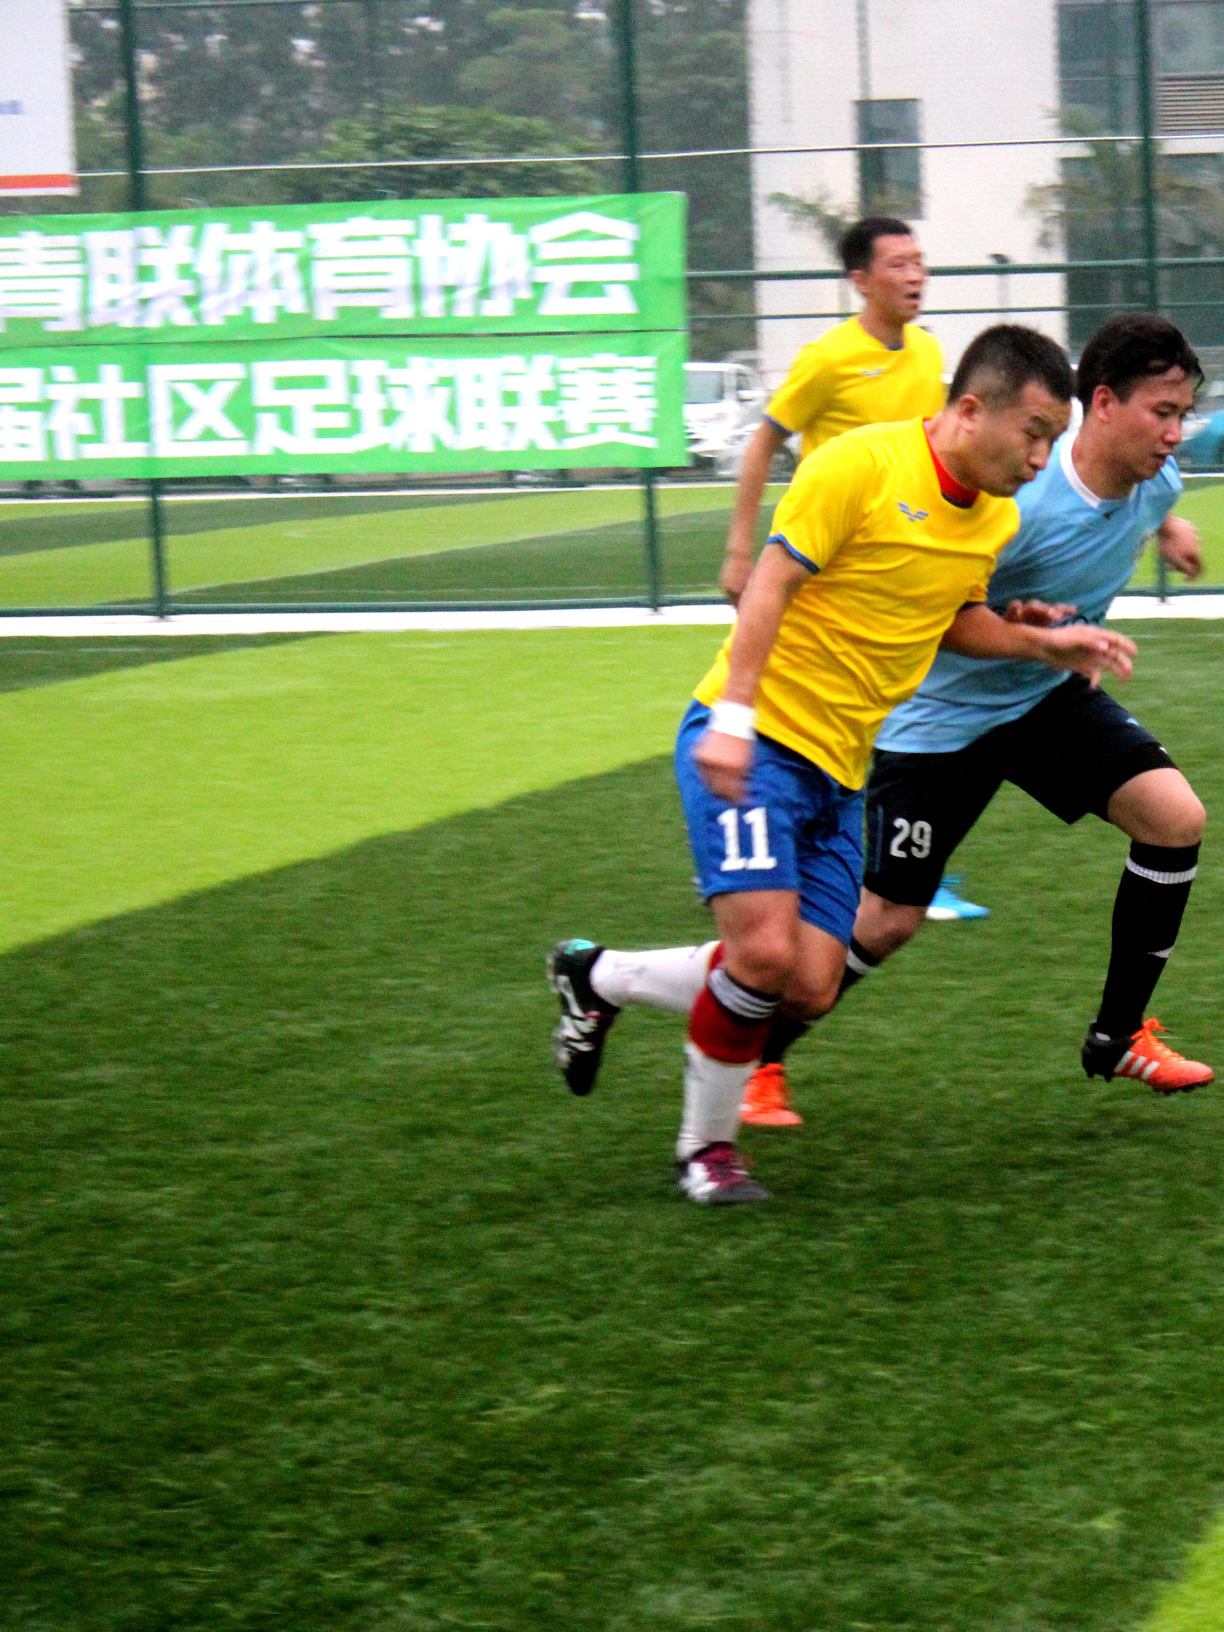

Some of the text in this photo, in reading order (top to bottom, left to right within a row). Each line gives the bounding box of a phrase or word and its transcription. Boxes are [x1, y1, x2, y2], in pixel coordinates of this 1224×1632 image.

[0, 211, 640, 333] 青联体育协会
[717, 806, 778, 872] 11
[889, 816, 933, 859] 29
